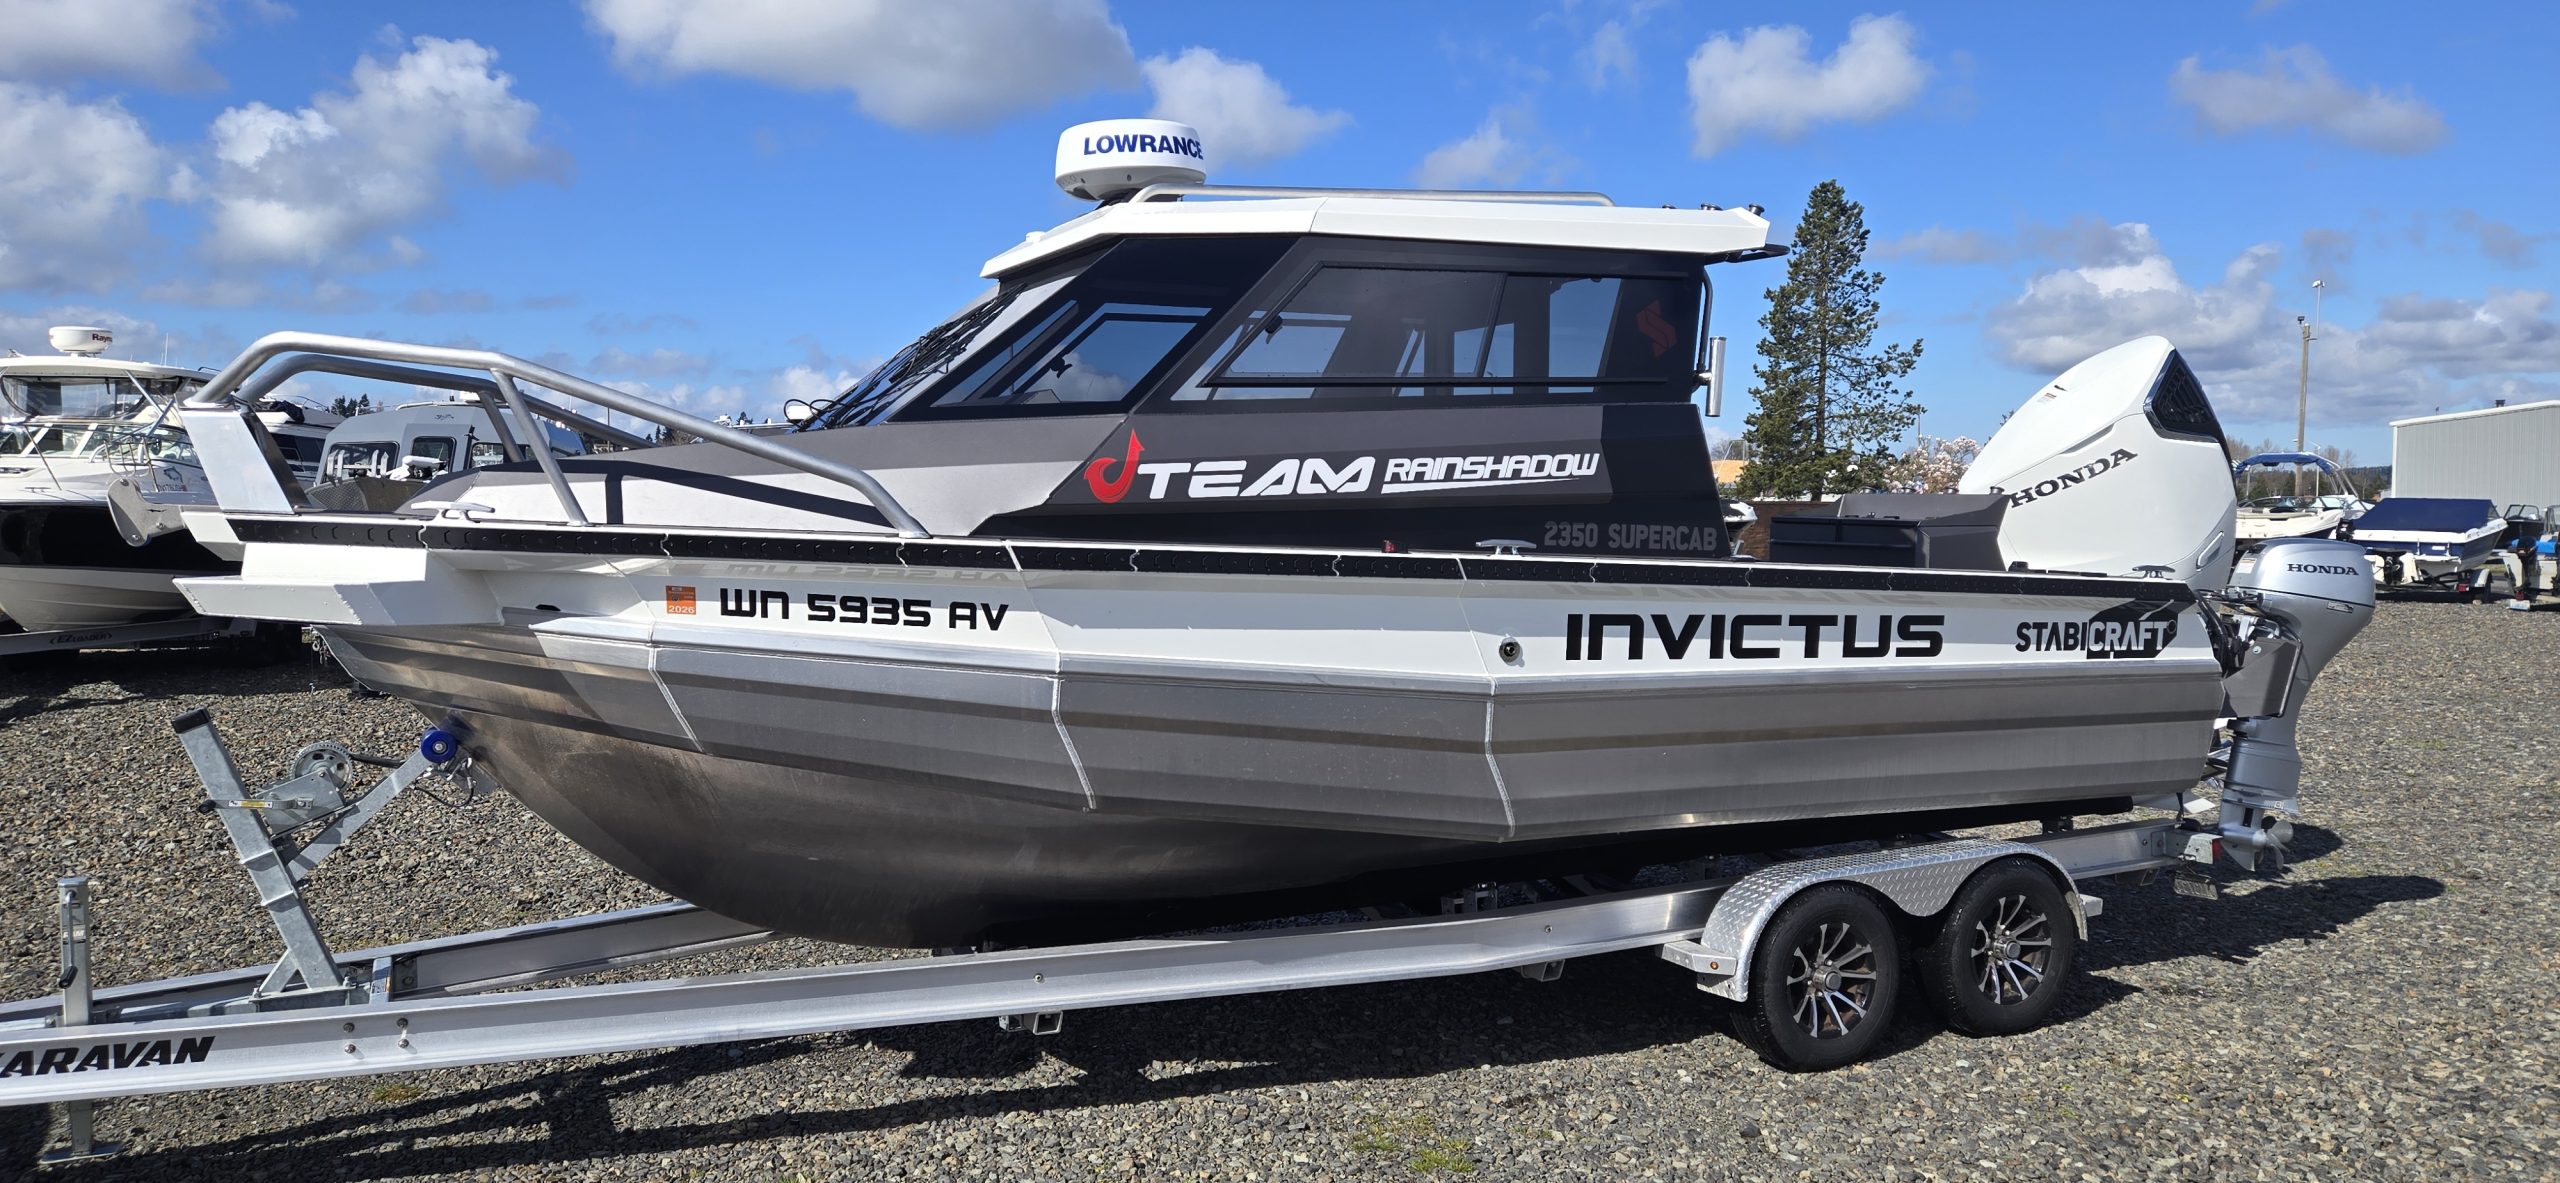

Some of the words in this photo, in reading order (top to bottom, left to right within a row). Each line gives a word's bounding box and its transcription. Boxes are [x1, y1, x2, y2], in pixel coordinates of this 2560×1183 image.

[1083, 134, 1204, 160] LOWRANCE
[1137, 456, 1376, 500] TEAM
[1384, 453, 1600, 483] RAINSHADOW
[2009, 448, 2139, 508] HONDA
[1544, 521, 1598, 548] 2350
[1607, 523, 1718, 551] SUPERCAB
[2287, 563, 2359, 576] HONDA
[668, 605, 695, 614] 2026
[720, 588, 789, 619] WN
[807, 593, 931, 627] 5935
[949, 601, 1009, 631] AV
[1566, 613, 1945, 660] INVICTUS
[2015, 621, 2169, 652] STABICRAFT
[0, 1035, 216, 1078] ARAVAN
